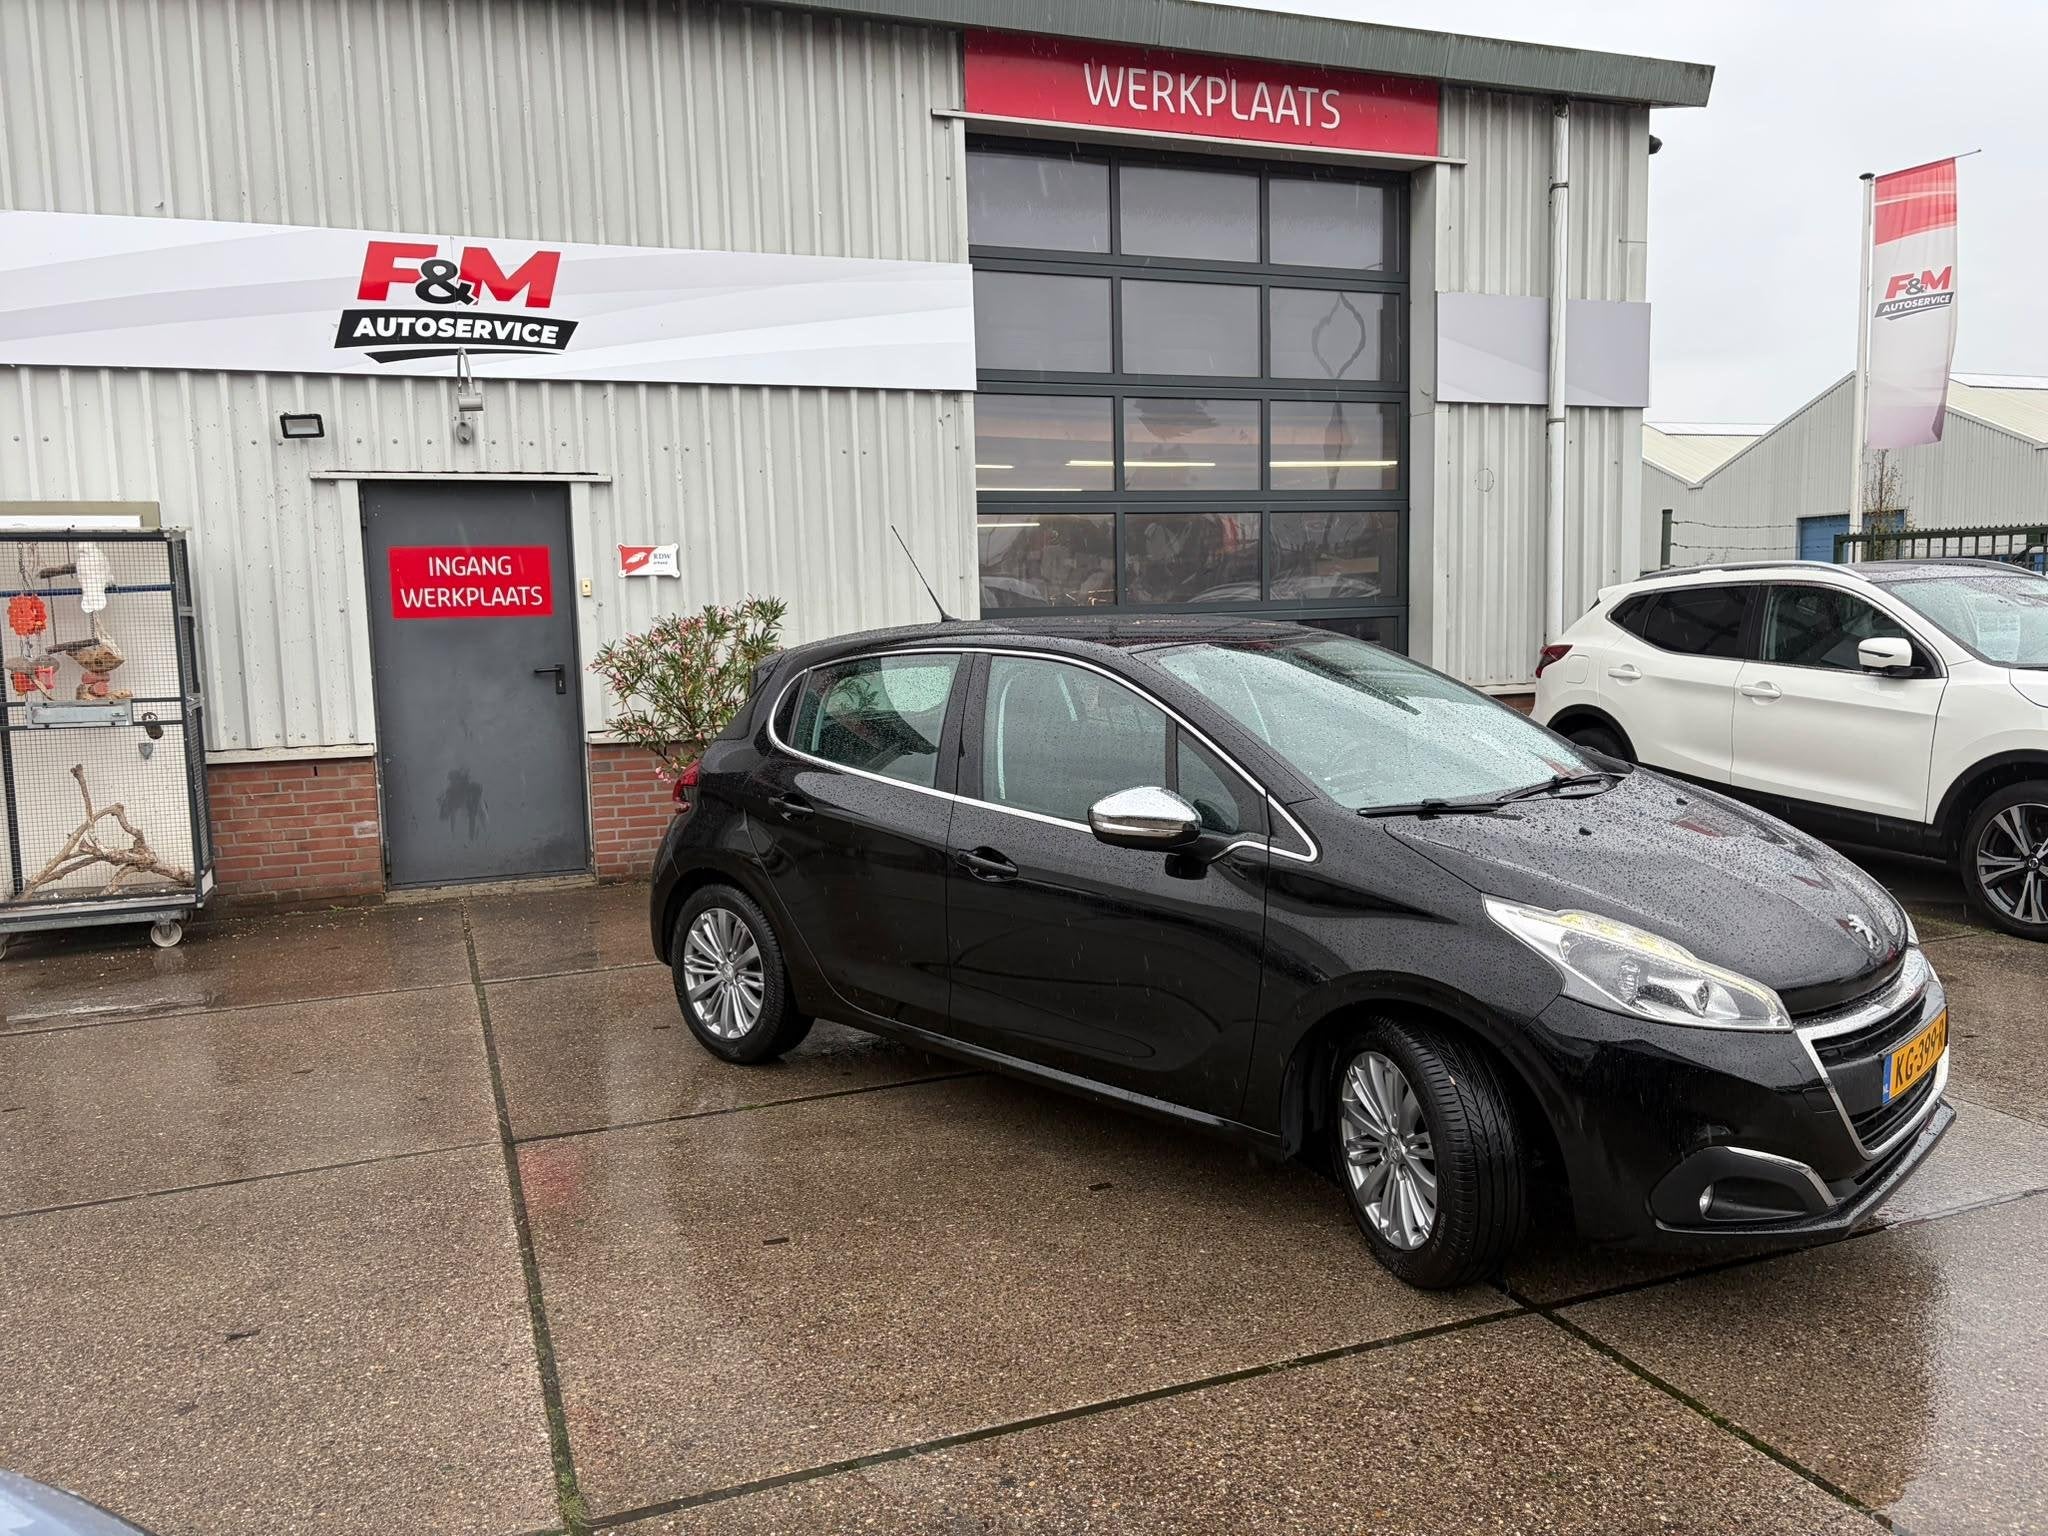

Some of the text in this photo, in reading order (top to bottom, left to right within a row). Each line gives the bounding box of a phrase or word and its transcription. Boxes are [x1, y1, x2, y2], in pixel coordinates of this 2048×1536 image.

[1084, 63, 1341, 129] WERKPLAATS
[357, 240, 561, 308] F&M
[1885, 266, 1952, 299] F&M
[1882, 295, 1951, 313] AUTOSERVICE
[352, 317, 559, 344] AUTOSERVICE
[428, 556, 512, 577] INGANG
[400, 586, 543, 608] WERKPLAATS
